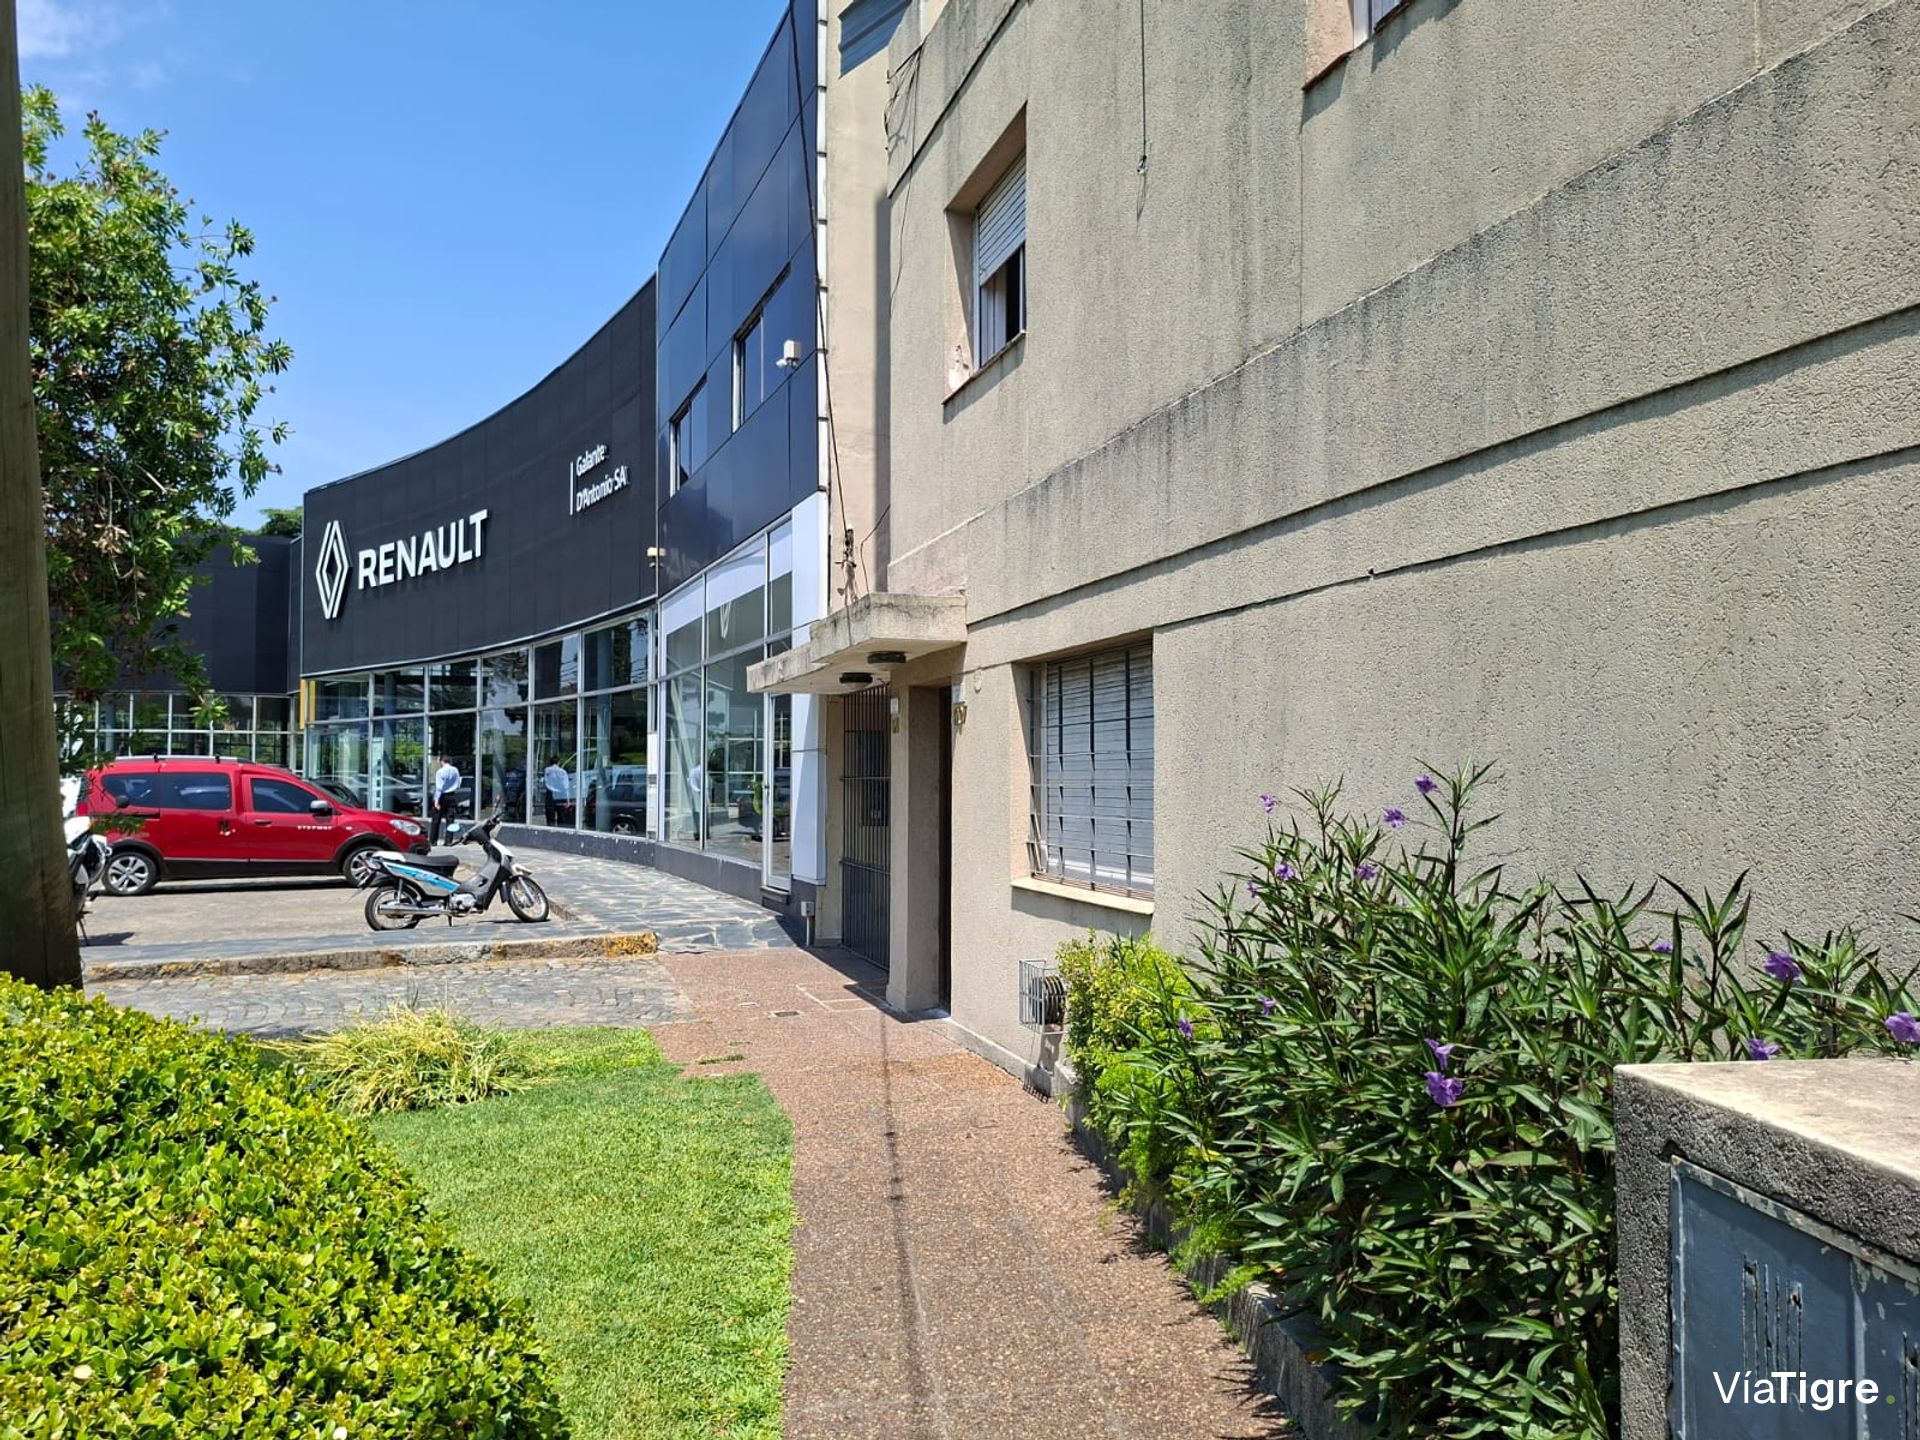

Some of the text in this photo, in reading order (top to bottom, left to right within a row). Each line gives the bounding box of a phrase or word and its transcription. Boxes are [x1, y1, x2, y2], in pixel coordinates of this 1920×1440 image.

[576, 444, 605, 477] Galante
[614, 465, 628, 491] SA
[358, 508, 487, 590] RENAULT
